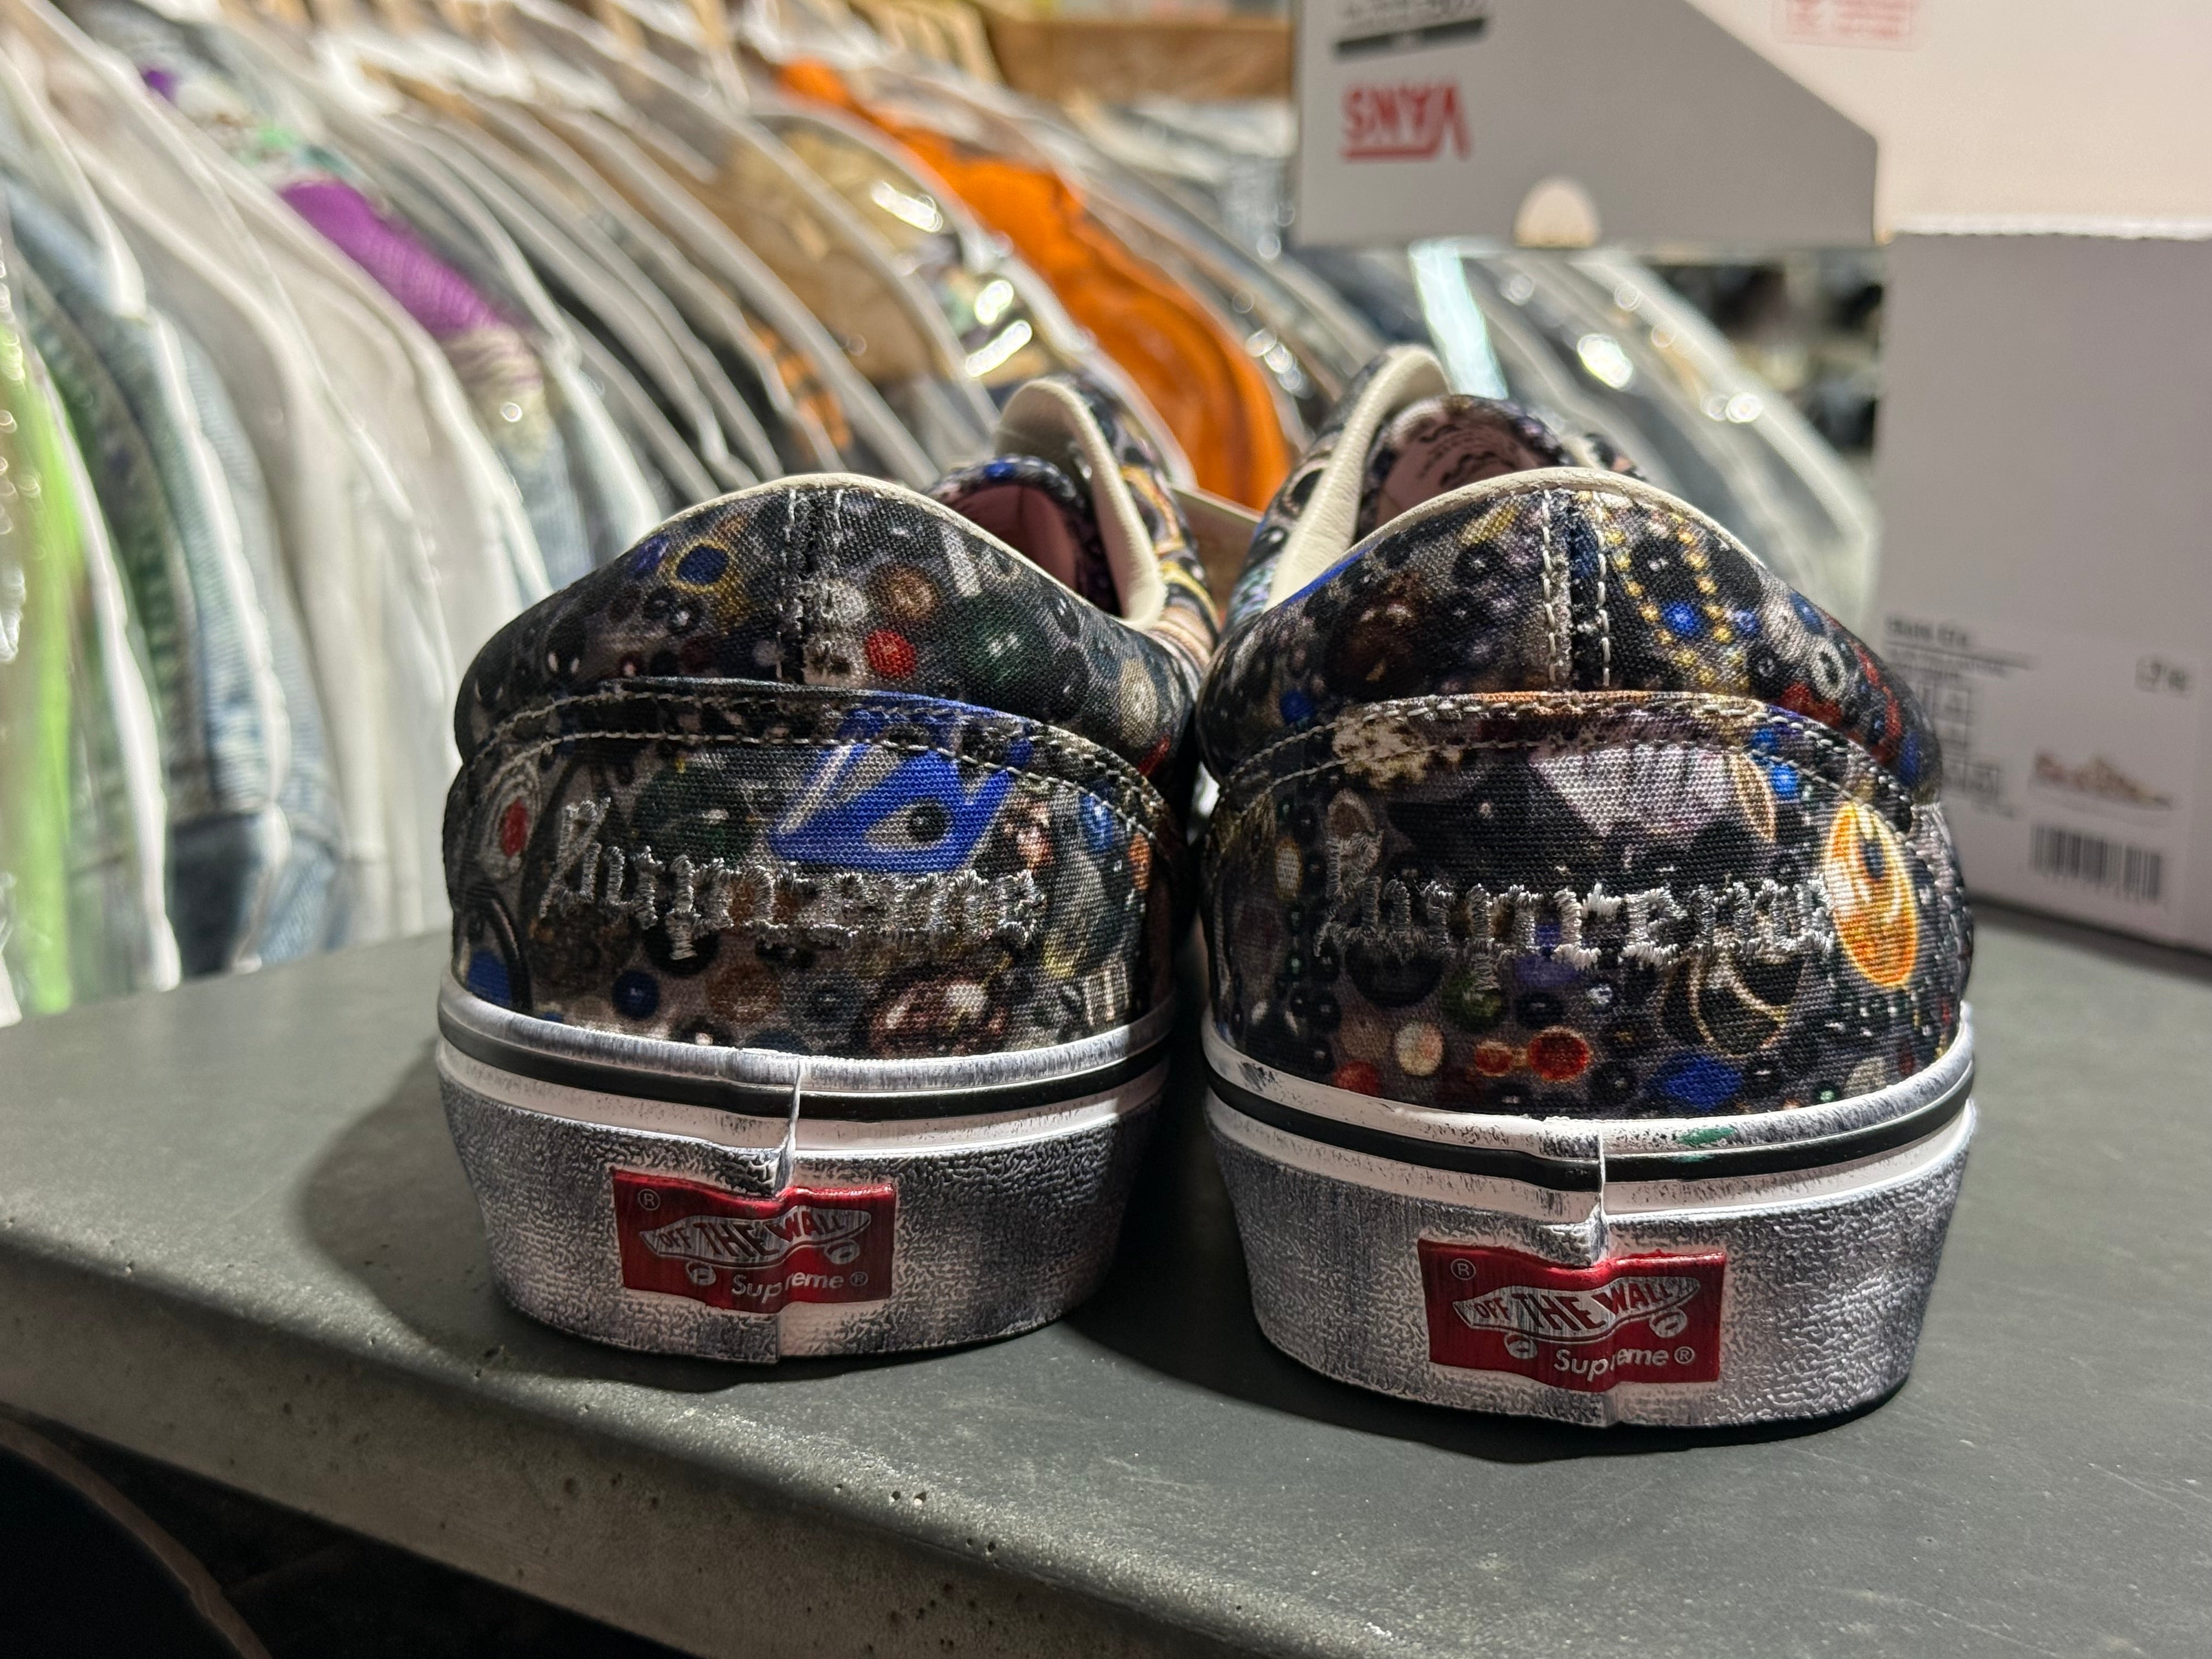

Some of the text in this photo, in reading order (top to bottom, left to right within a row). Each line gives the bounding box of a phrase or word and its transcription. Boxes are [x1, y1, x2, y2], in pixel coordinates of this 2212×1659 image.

[693, 1222, 782, 1258] THE
[765, 1210, 845, 1242] WALL
[731, 1271, 844, 1304] Supreme
[1511, 1293, 1607, 1331] THE
[1590, 1281, 1673, 1315] WALL
[1554, 1347, 1669, 1383] Supreme
